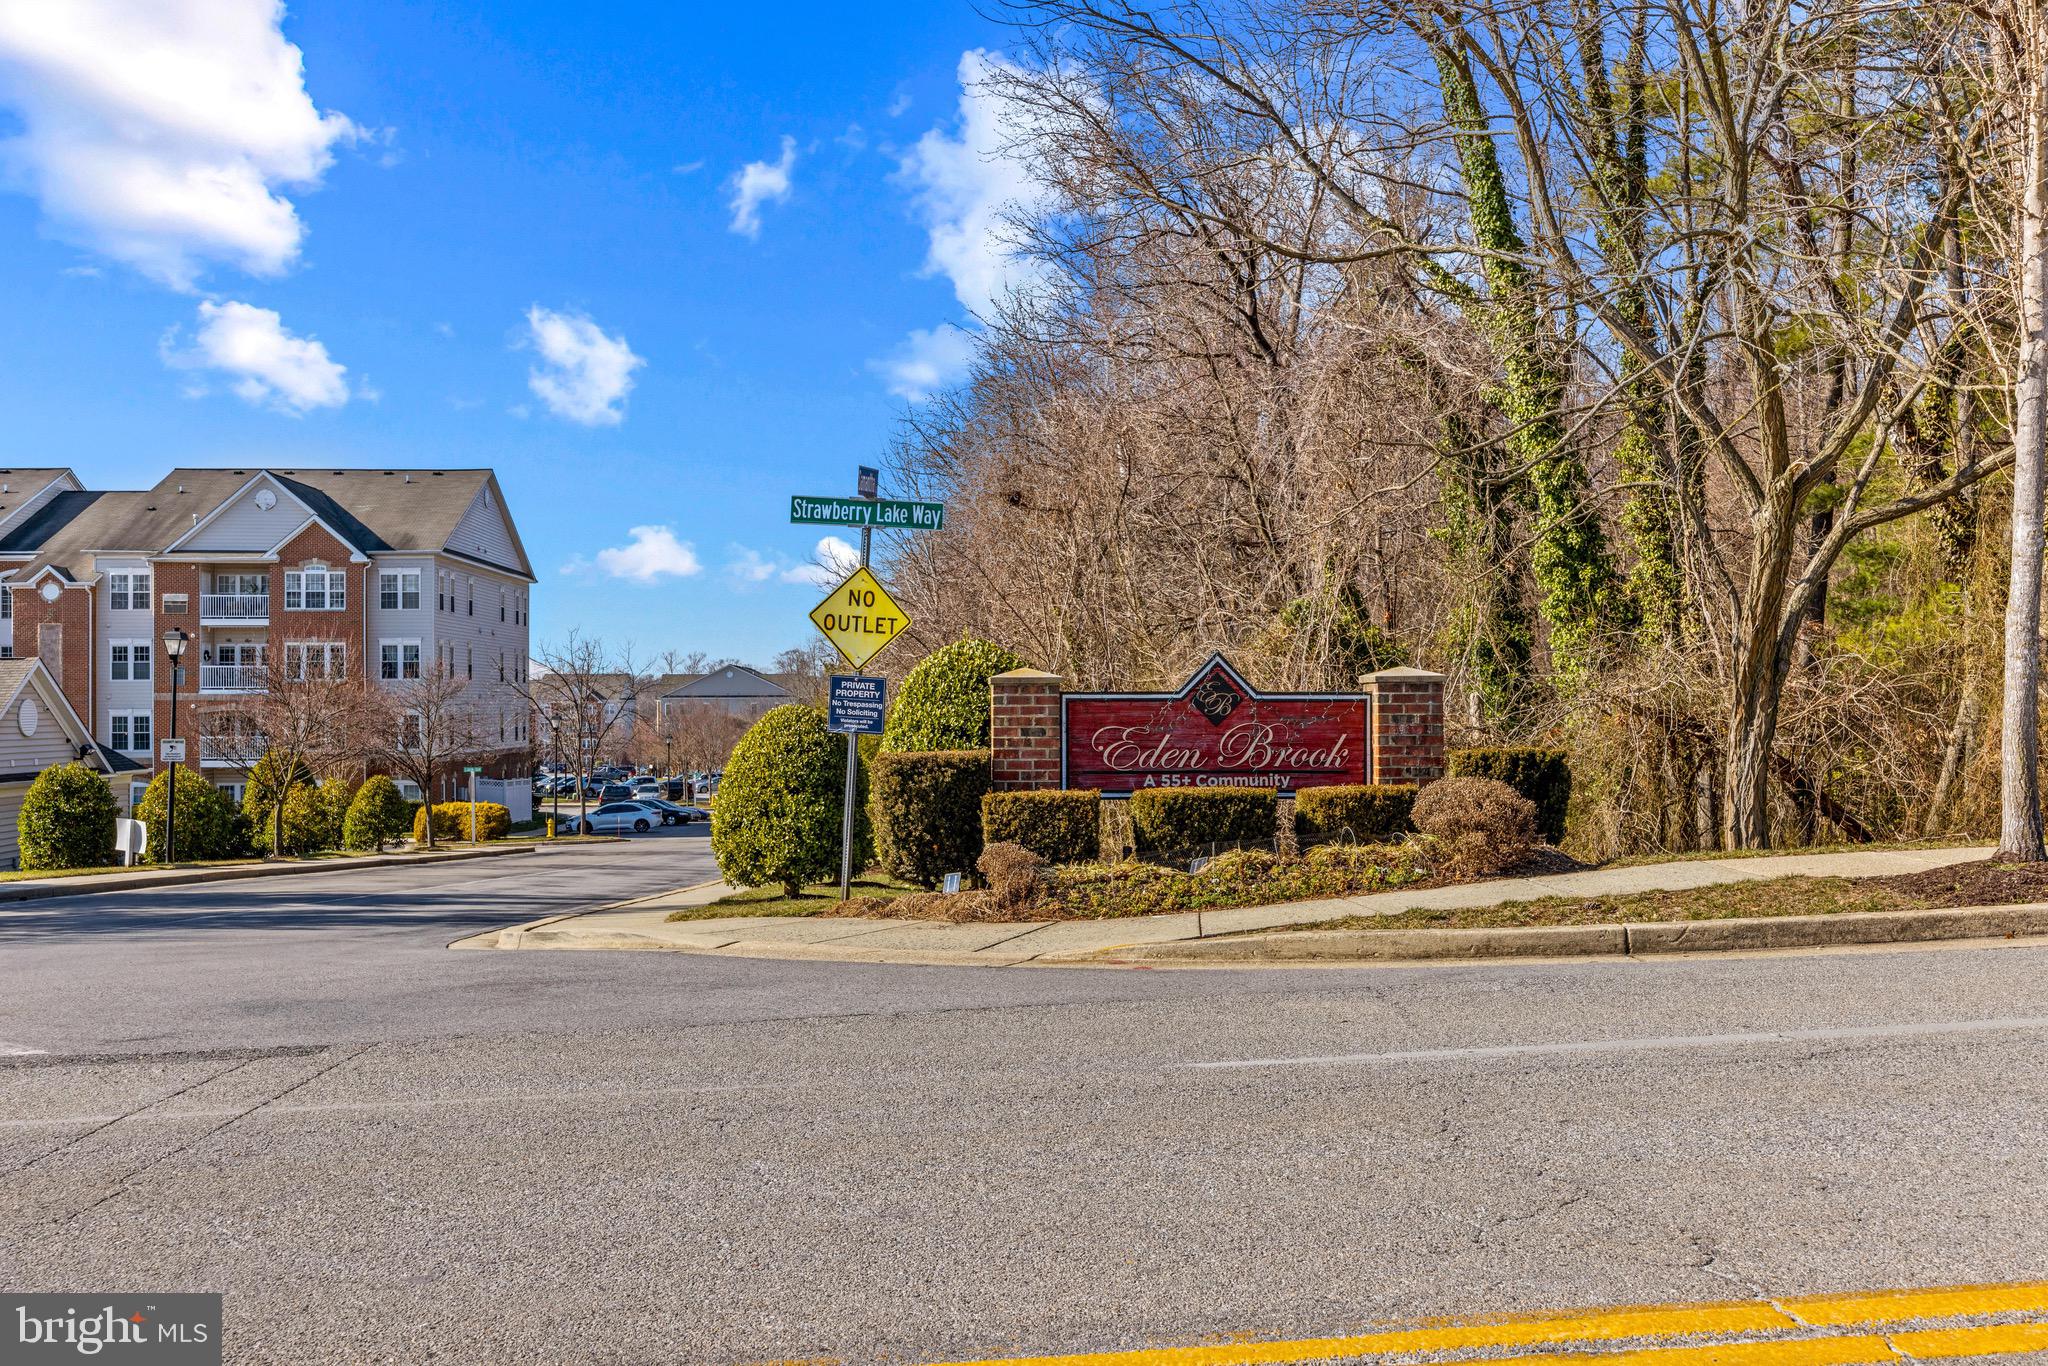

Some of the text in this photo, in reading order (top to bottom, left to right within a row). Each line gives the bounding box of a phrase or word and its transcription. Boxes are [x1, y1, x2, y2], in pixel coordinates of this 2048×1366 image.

[793, 498, 941, 530] Strawberry Lake Way
[848, 589, 876, 608] NO
[823, 613, 898, 635] OUTLET
[841, 681, 875, 690] PRIVATE
[835, 689, 880, 698] PROPERTY
[843, 700, 883, 710] Trespassing
[847, 708, 878, 717] Soliciting
[1092, 722, 1348, 771] Eden Brook
[1143, 773, 1290, 788] A 55+ Community
